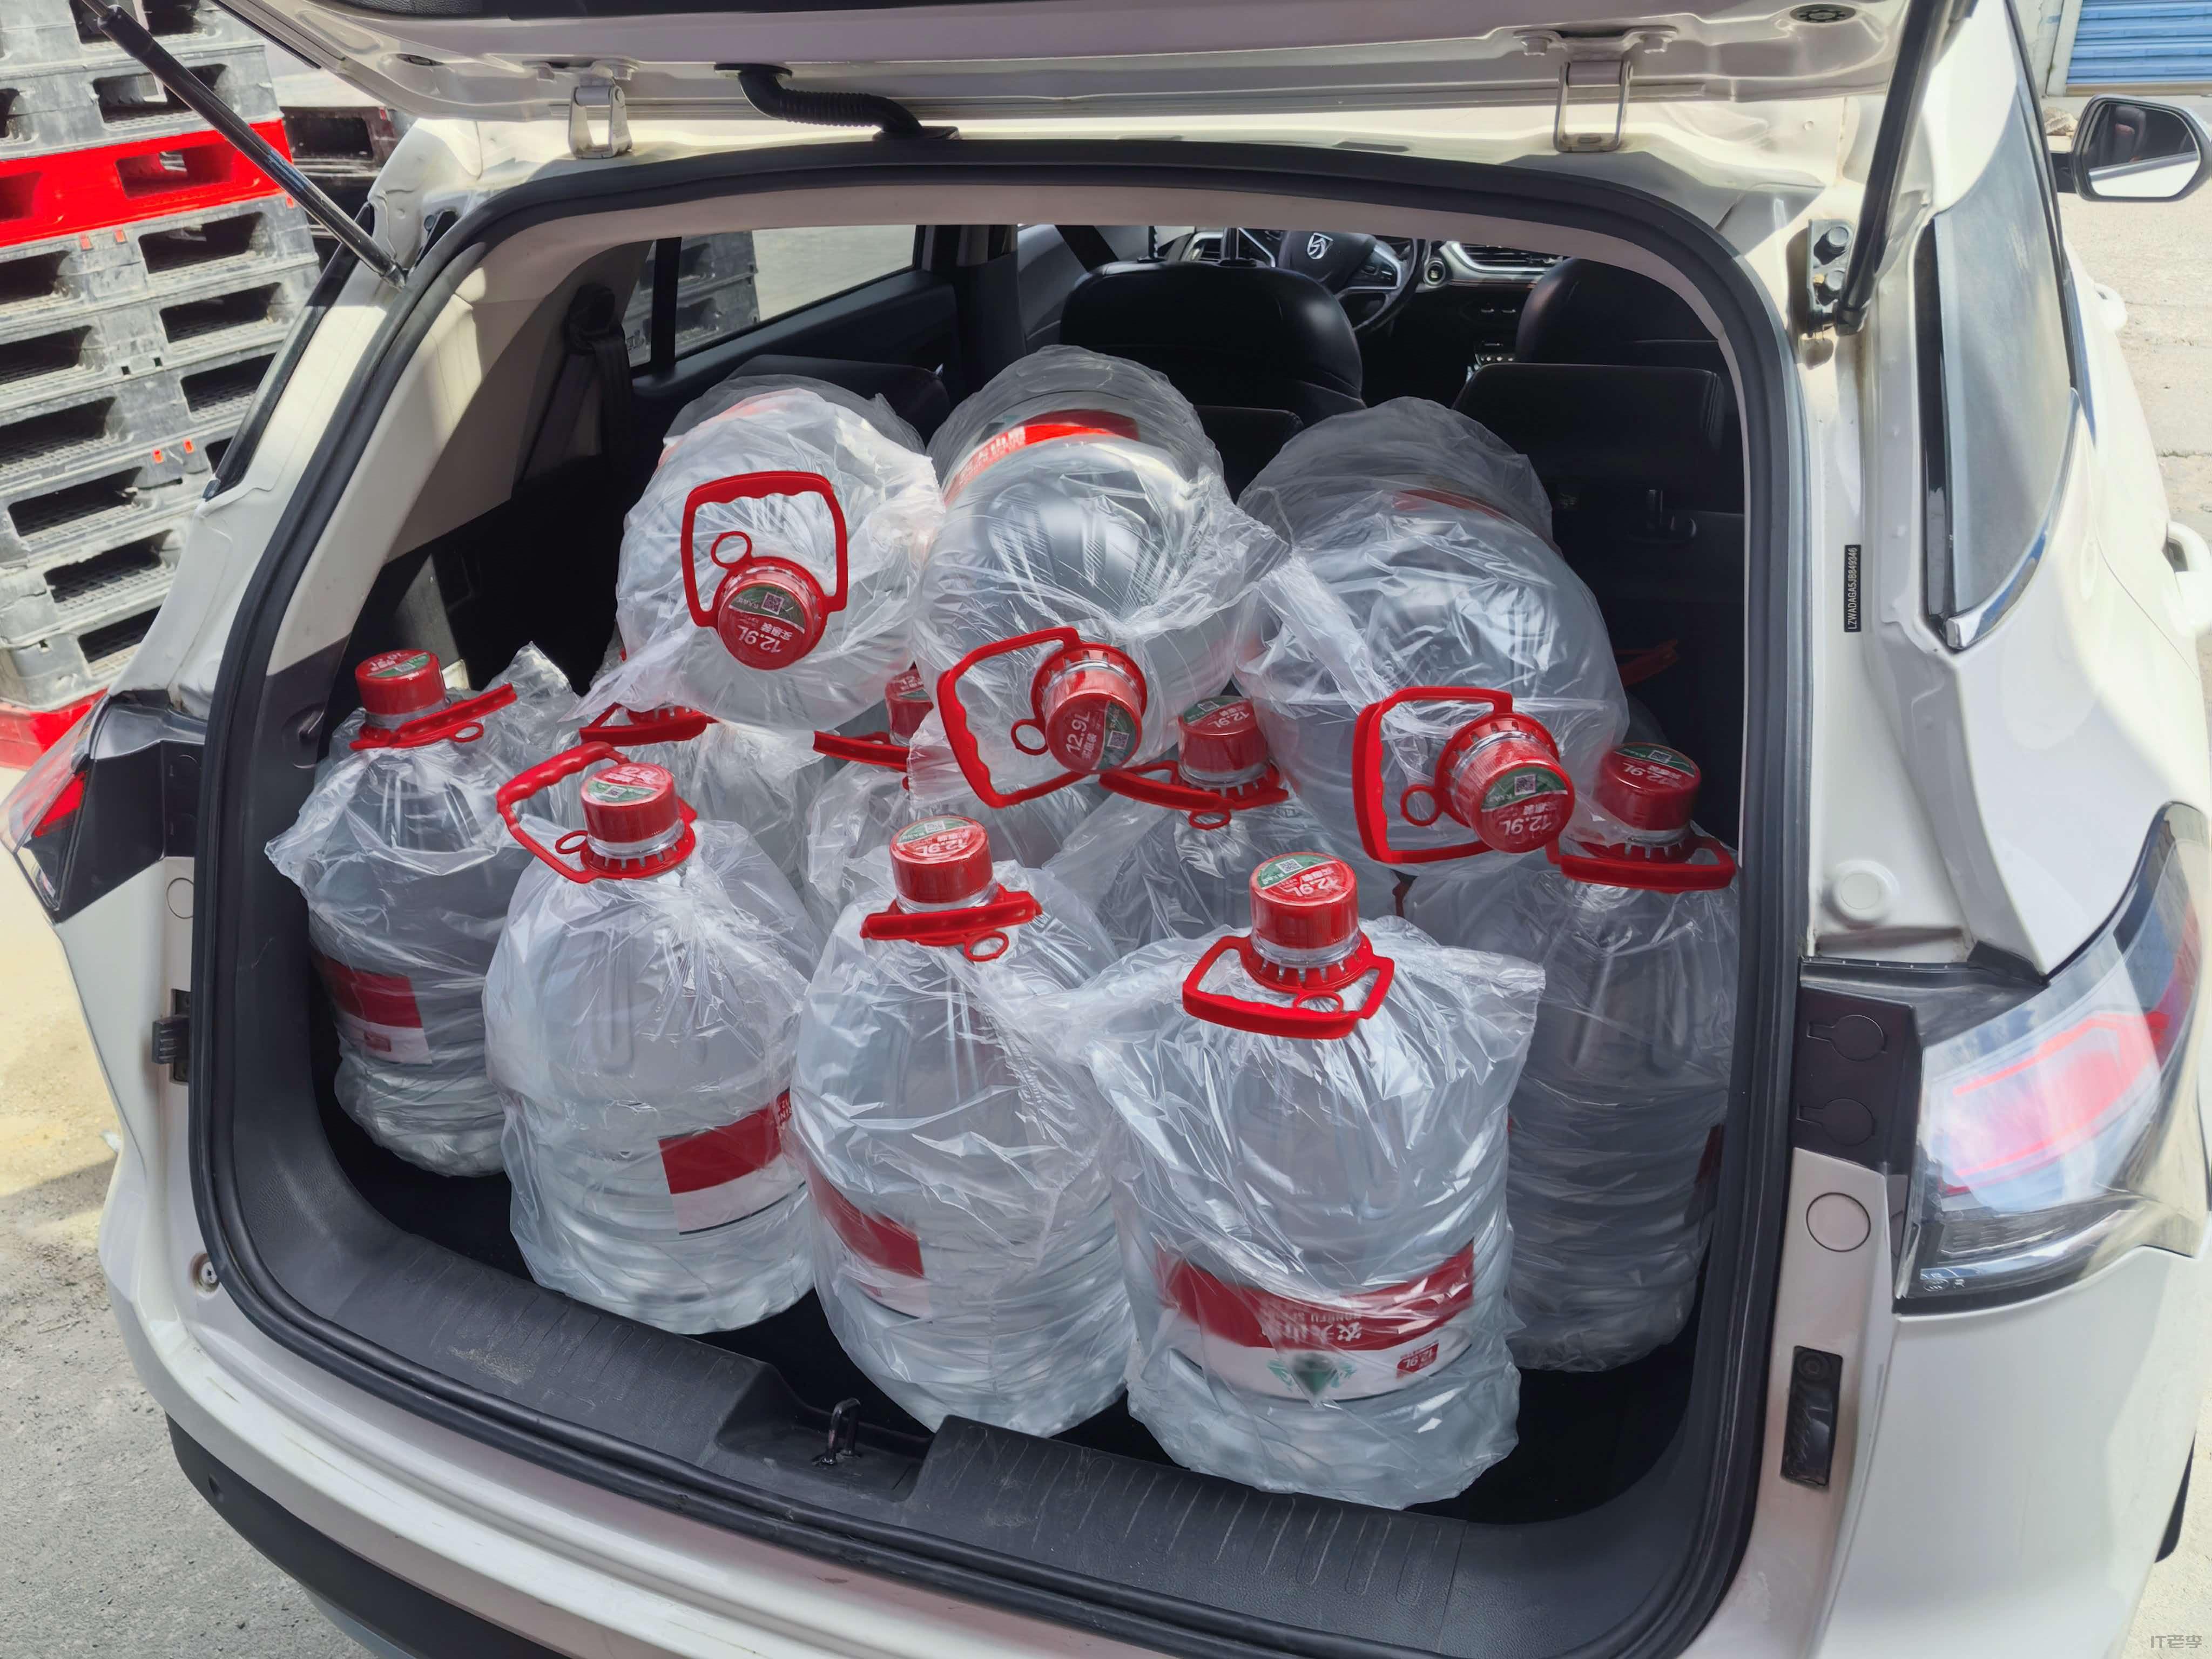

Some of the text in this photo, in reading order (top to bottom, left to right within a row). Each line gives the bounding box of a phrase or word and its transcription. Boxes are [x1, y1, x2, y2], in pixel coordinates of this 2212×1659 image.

[738, 624, 781, 653] 12.9L
[1209, 711, 1250, 727] 12.9L
[1065, 711, 1090, 754] 12.9L
[1499, 814, 1552, 835] 12.9L
[916, 839, 968, 855] 12.9L
[1282, 876, 1338, 896] 12.9L
